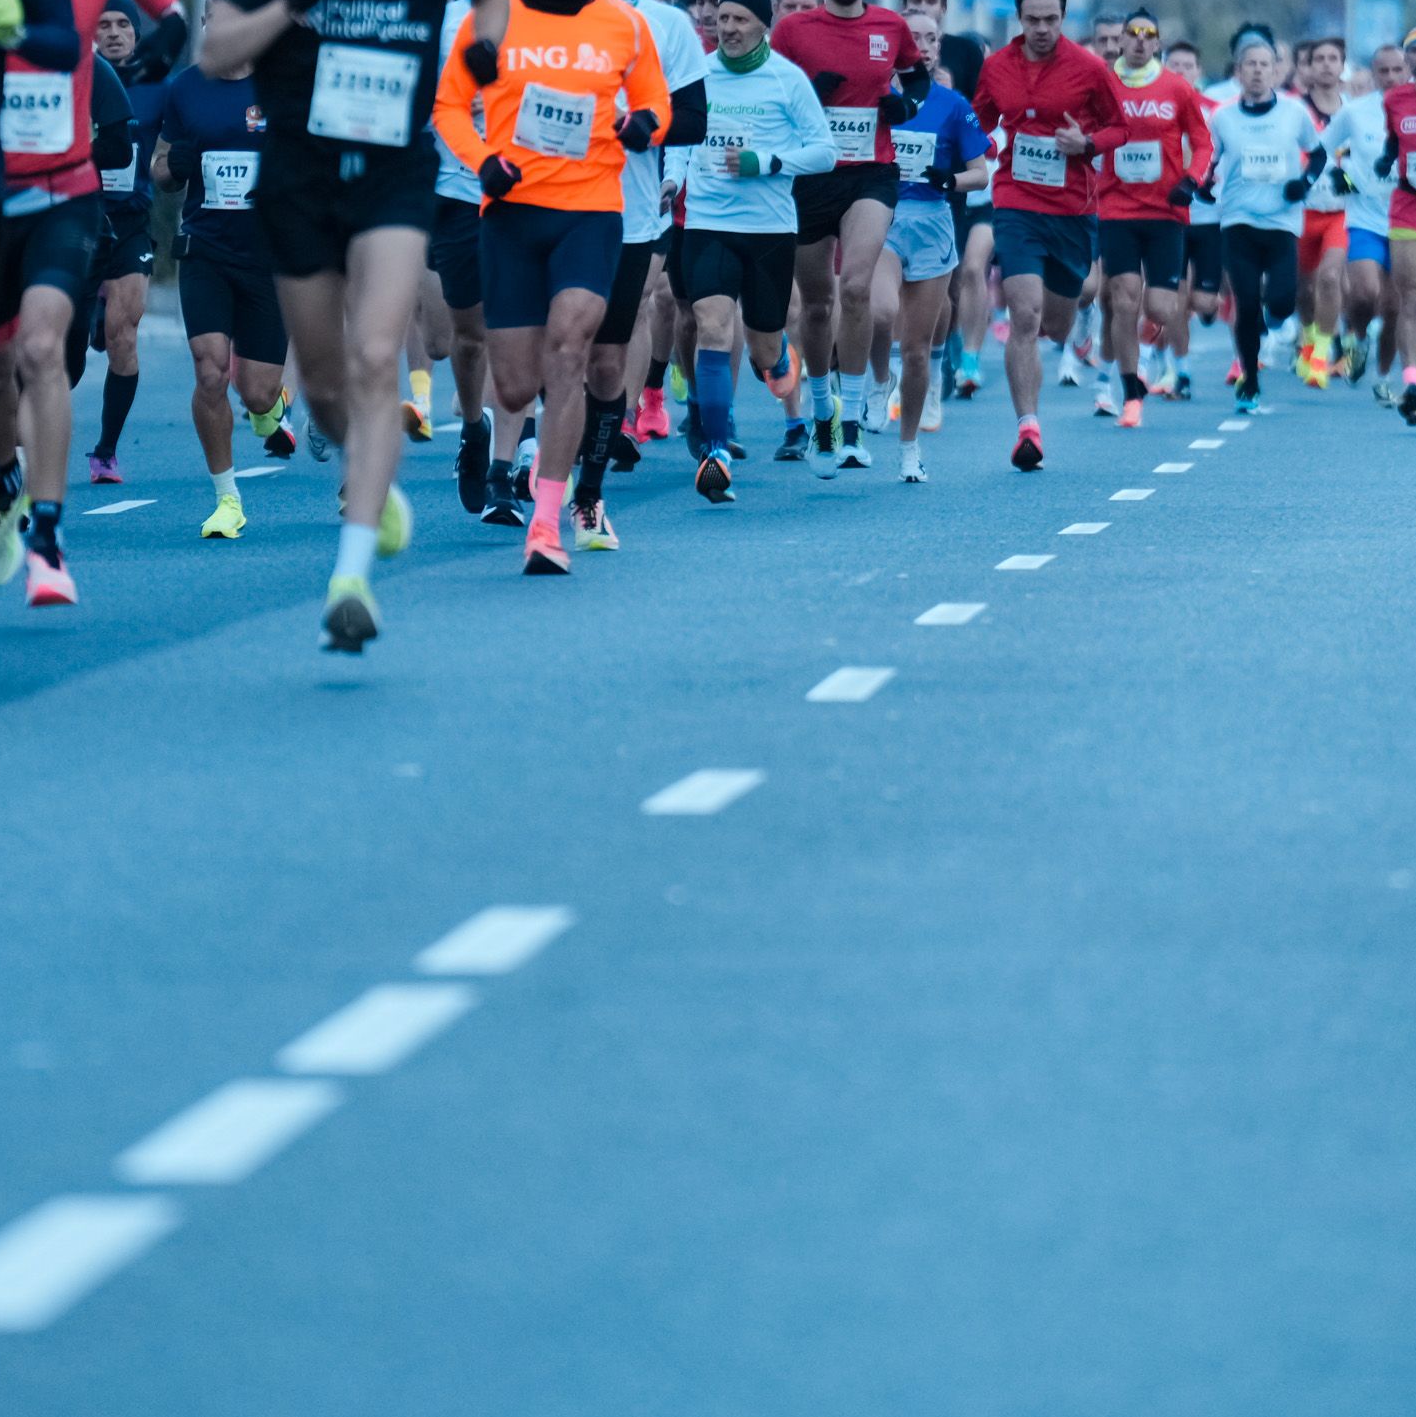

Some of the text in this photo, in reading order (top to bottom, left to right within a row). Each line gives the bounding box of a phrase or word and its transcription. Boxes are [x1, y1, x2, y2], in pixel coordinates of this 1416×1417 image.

[506, 46, 568, 72] ING
[3, 93, 62, 110] 0849
[534, 102, 584, 126] 18153
[828, 120, 871, 133] 26461
[704, 135, 744, 148] 16343
[1018, 145, 1061, 161] 26462
[215, 165, 249, 178] 4117
